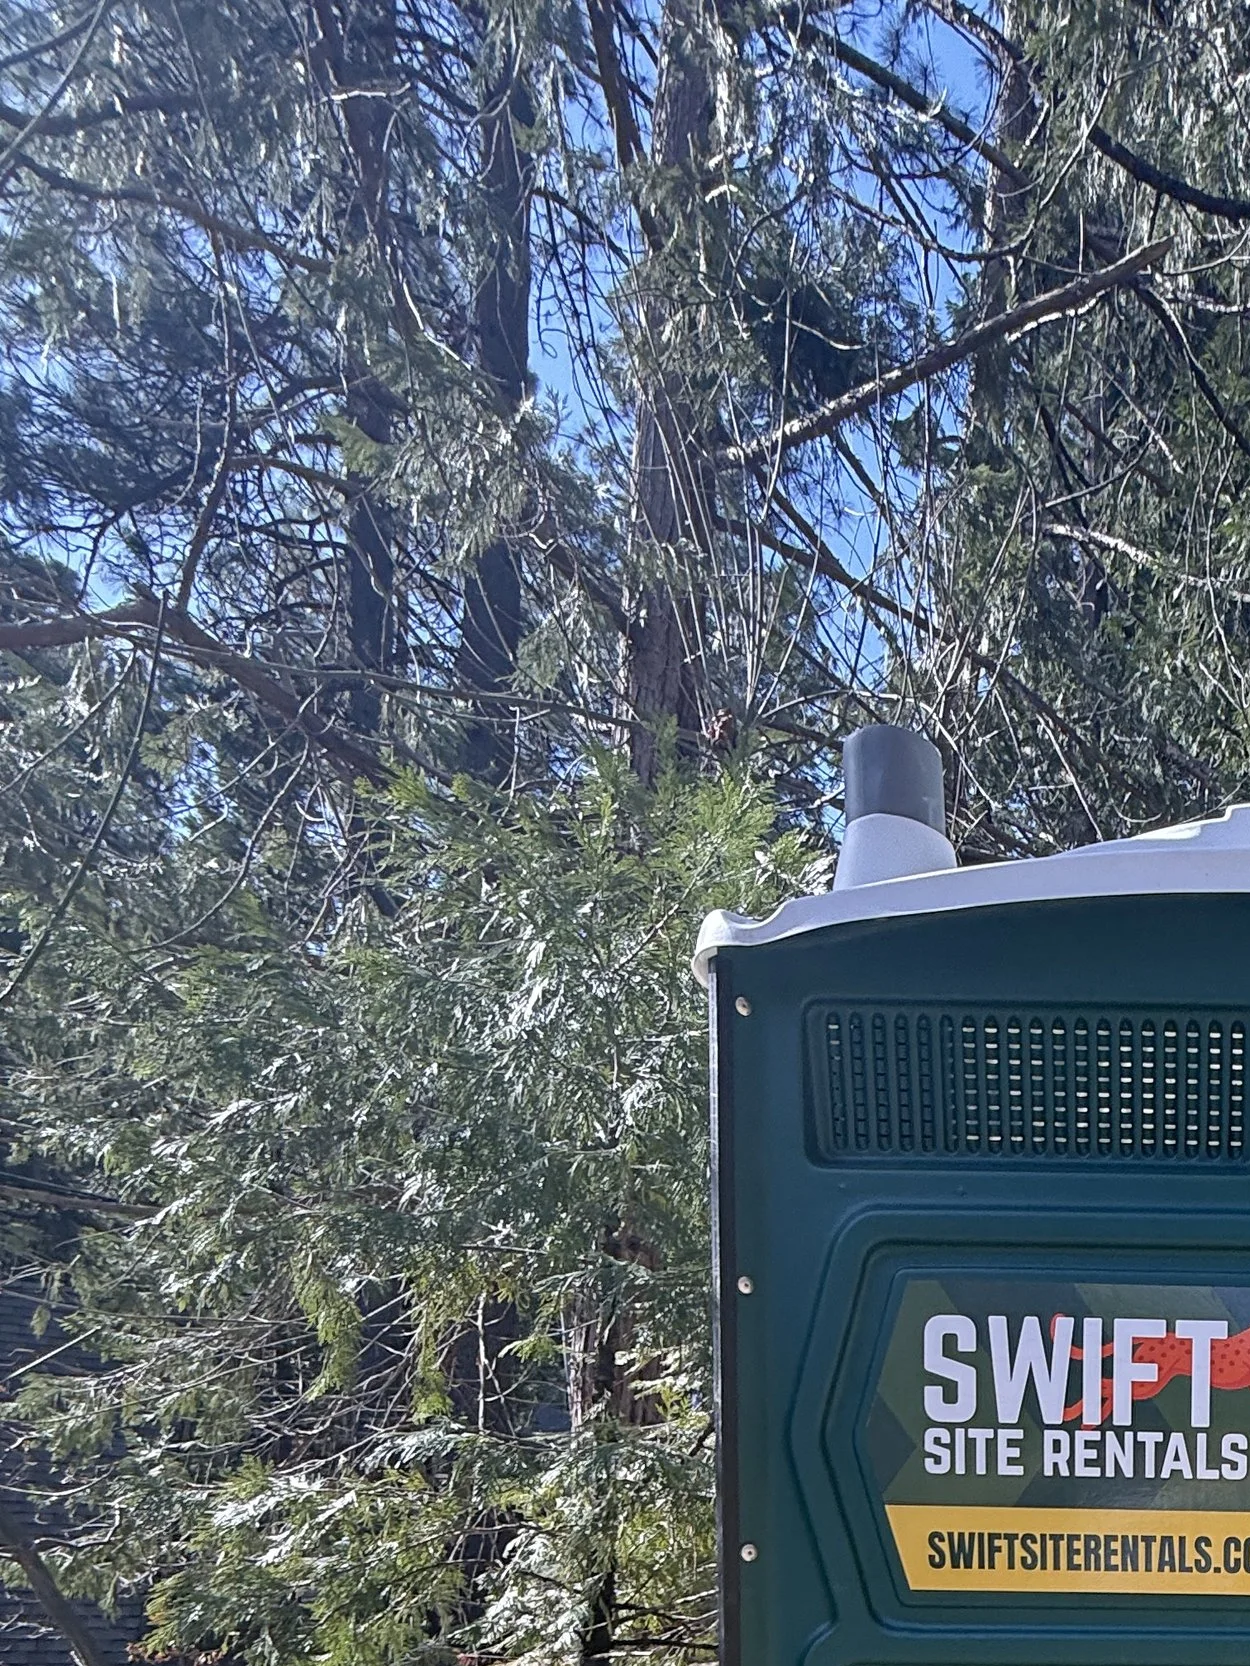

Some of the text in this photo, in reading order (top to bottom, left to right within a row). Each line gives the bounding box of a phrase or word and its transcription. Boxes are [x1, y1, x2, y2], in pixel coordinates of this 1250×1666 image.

[923, 1314, 1229, 1428] SWIFT
[923, 1428, 1249, 1480] SITE RENTALS
